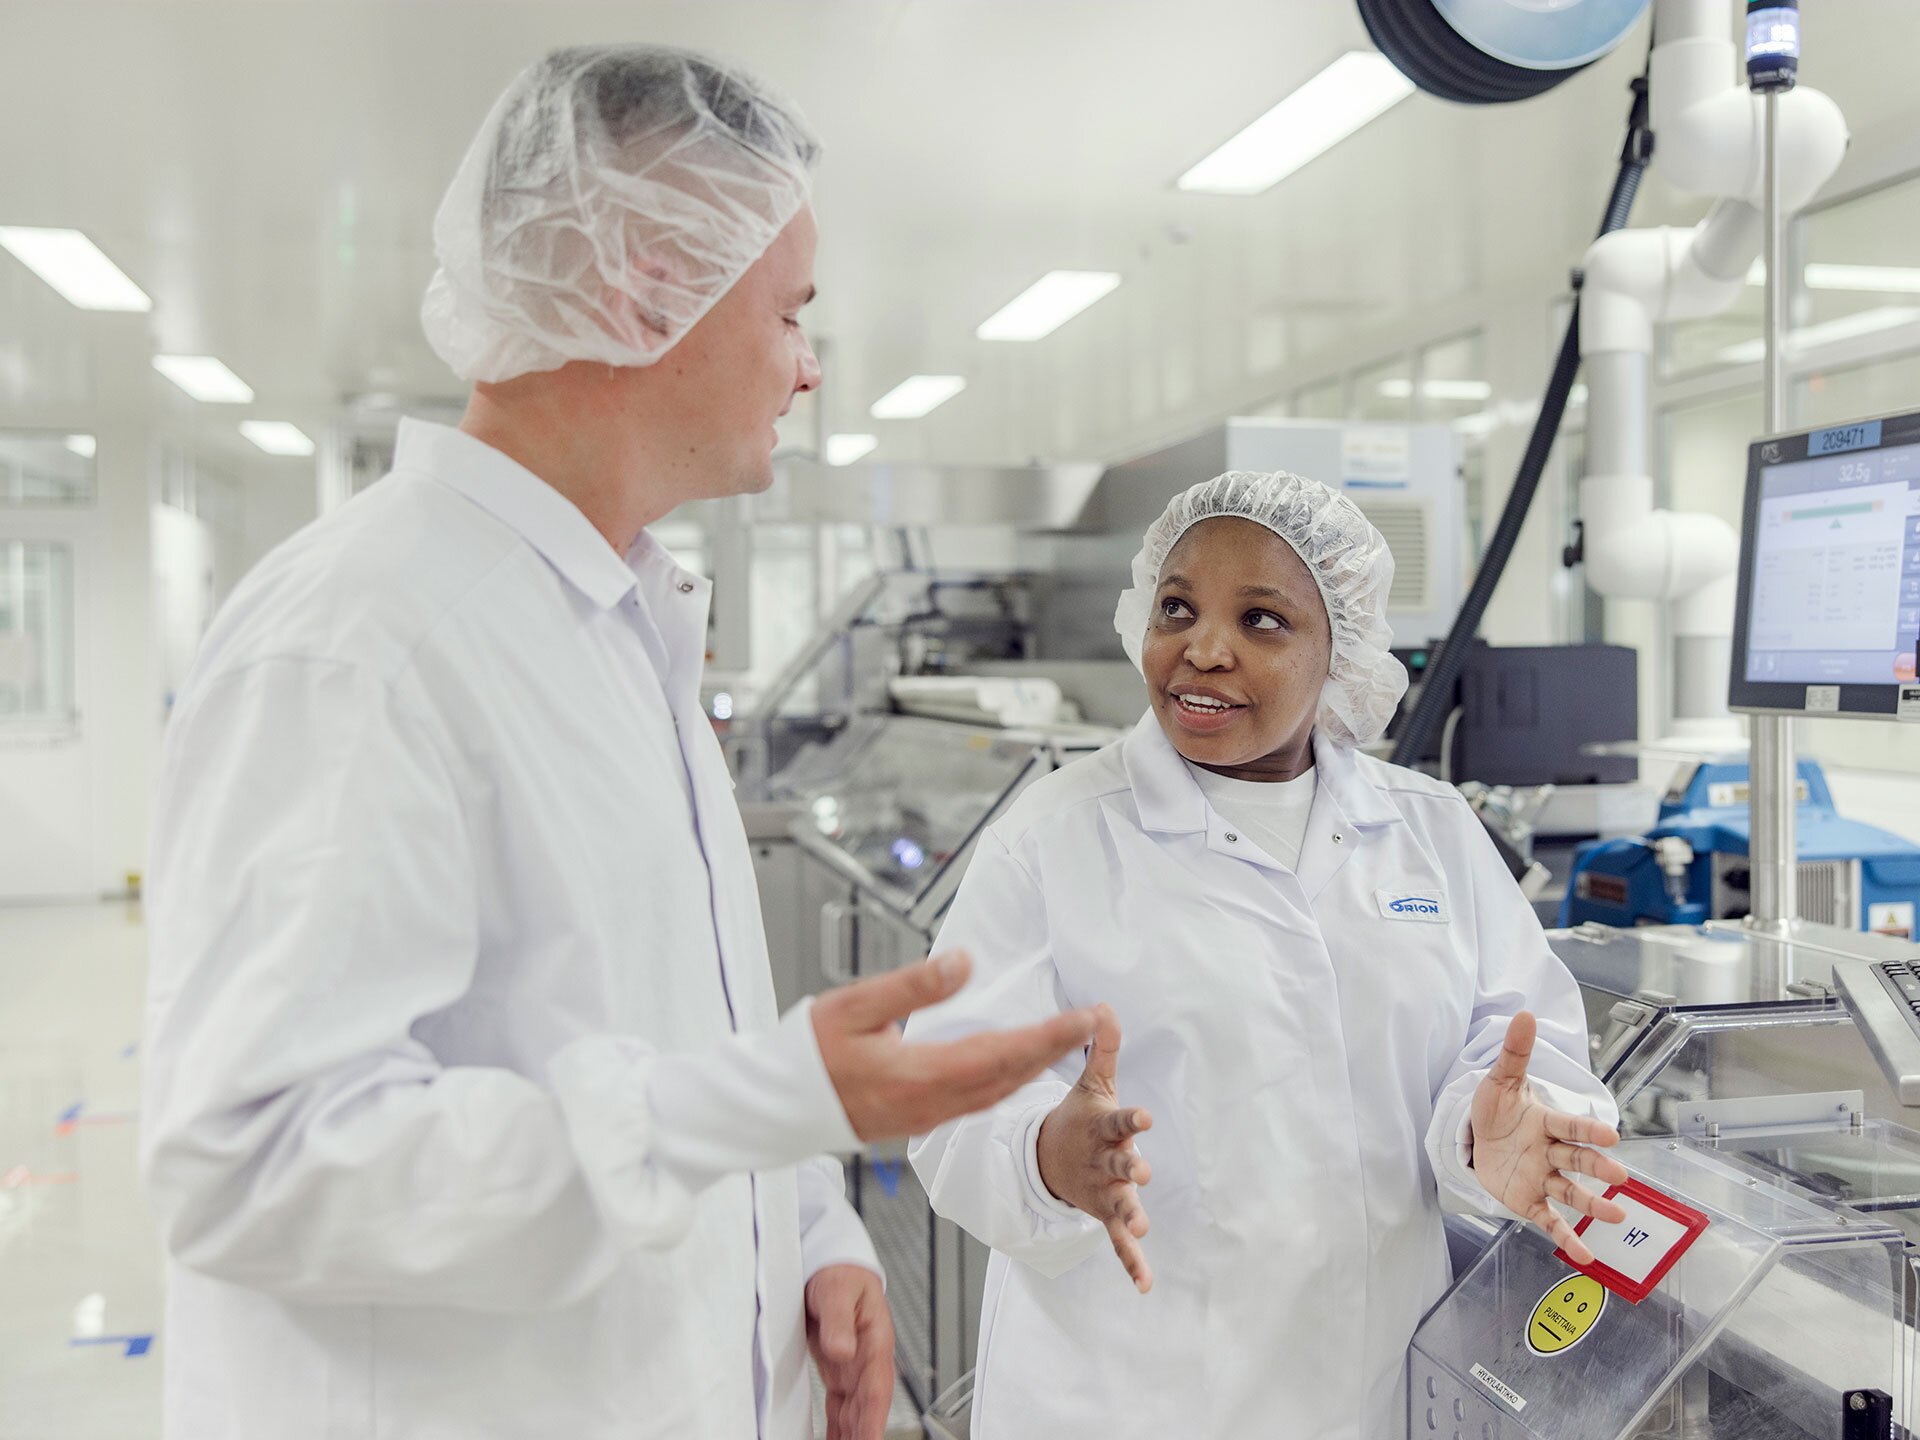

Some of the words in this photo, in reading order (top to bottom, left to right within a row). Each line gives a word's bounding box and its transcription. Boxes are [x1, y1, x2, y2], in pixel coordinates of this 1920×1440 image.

[1821, 428, 1865, 451] 209471
[1389, 899, 1439, 913] ORION
[1623, 1227, 1649, 1247] H7
[1544, 1307, 1576, 1335] PURETTAVA
[1477, 1369, 1518, 1404] HYLKYLAATIKKO
